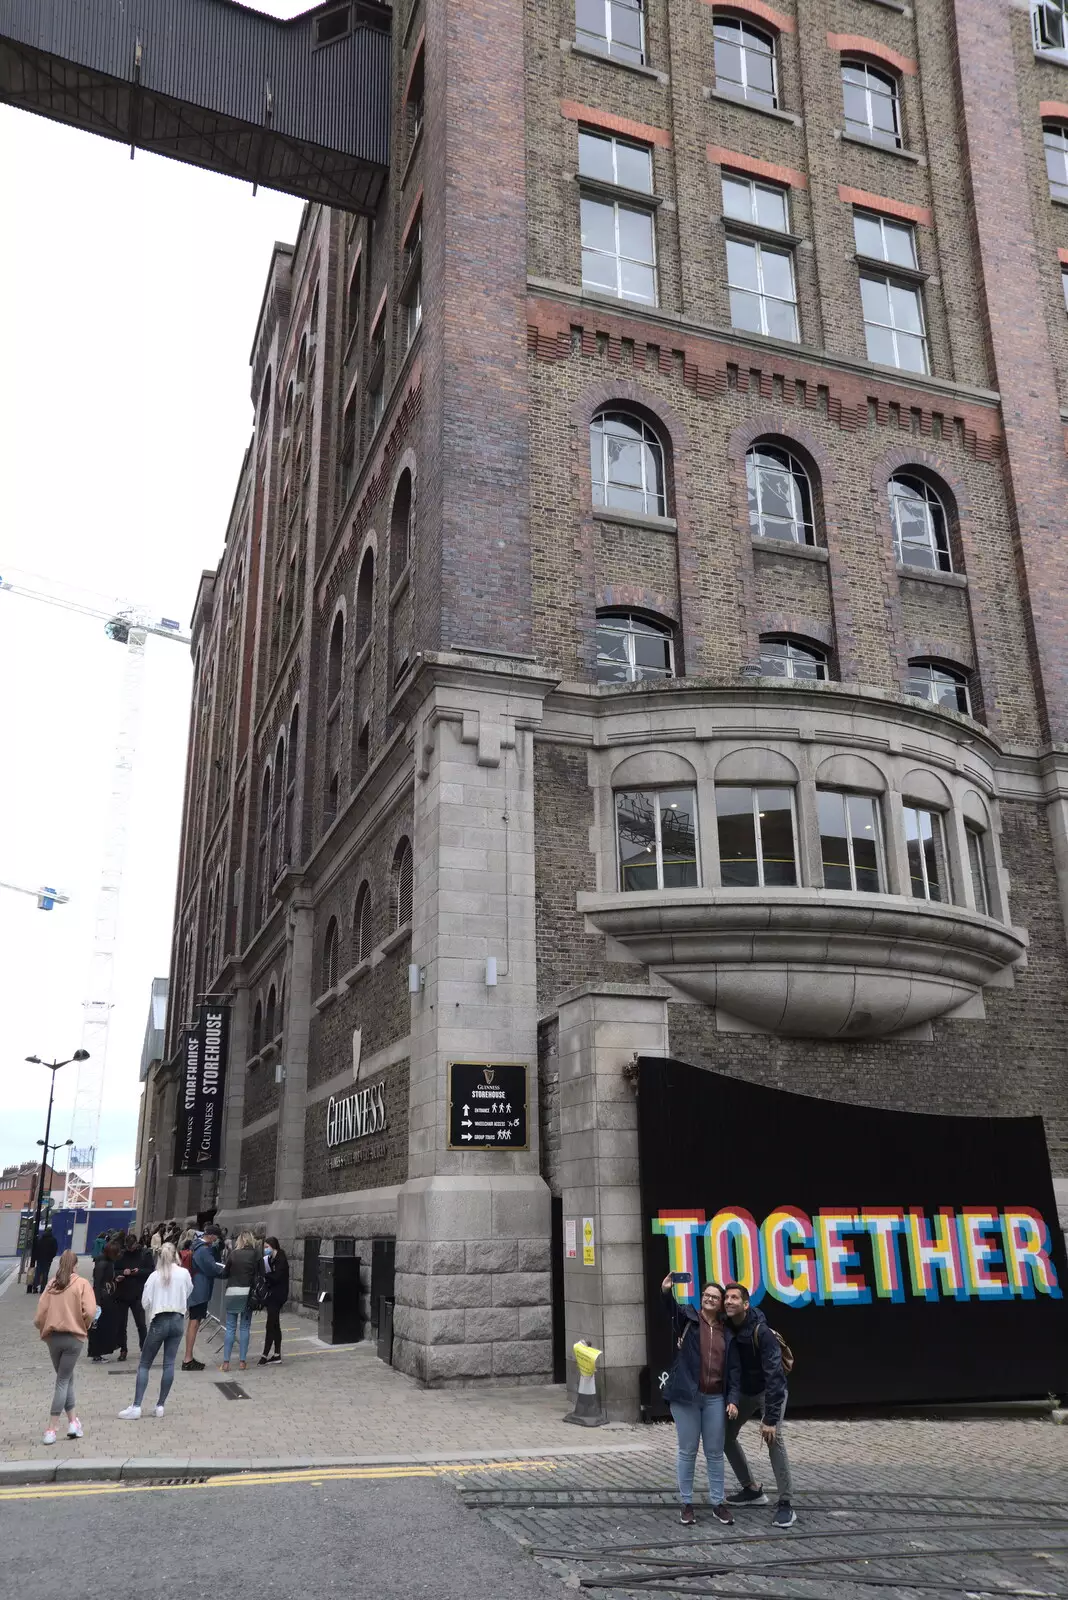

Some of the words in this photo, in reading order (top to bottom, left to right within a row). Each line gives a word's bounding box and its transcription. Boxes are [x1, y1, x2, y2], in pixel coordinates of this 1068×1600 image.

[202, 1012, 222, 1095] STOREHOUSE
[201, 1102, 214, 1150] GUINNESS
[472, 1090, 506, 1098] STOREHOUSE
[651, 1205, 1064, 1309] TOGETHER
